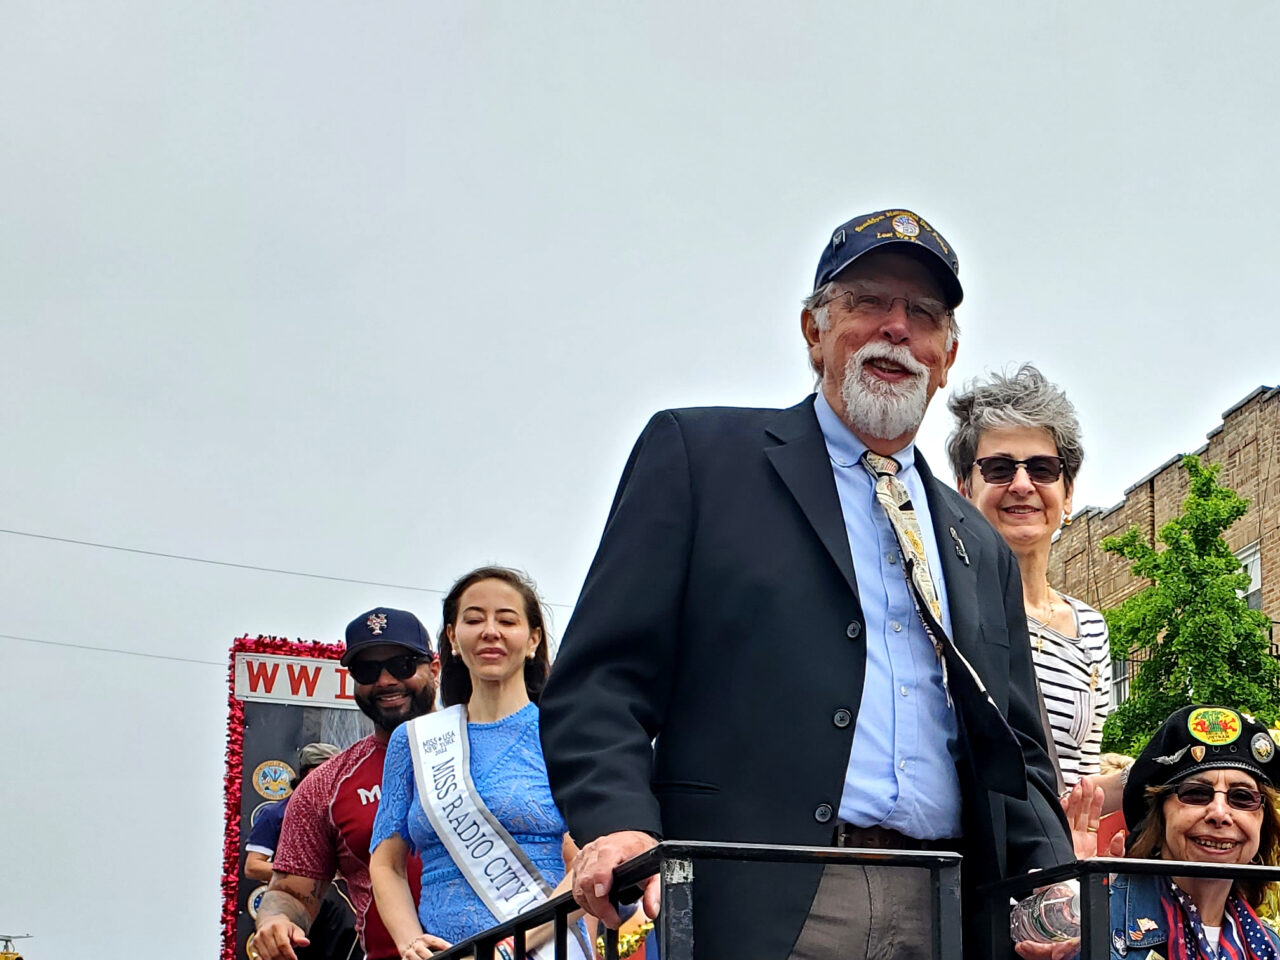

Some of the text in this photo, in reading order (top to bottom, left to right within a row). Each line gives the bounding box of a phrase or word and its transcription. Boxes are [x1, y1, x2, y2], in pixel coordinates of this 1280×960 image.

[245, 660, 323, 698] WW
[431, 756, 458, 801] MISS
[442, 794, 495, 860] RADIO
[483, 857, 530, 903] CITY
